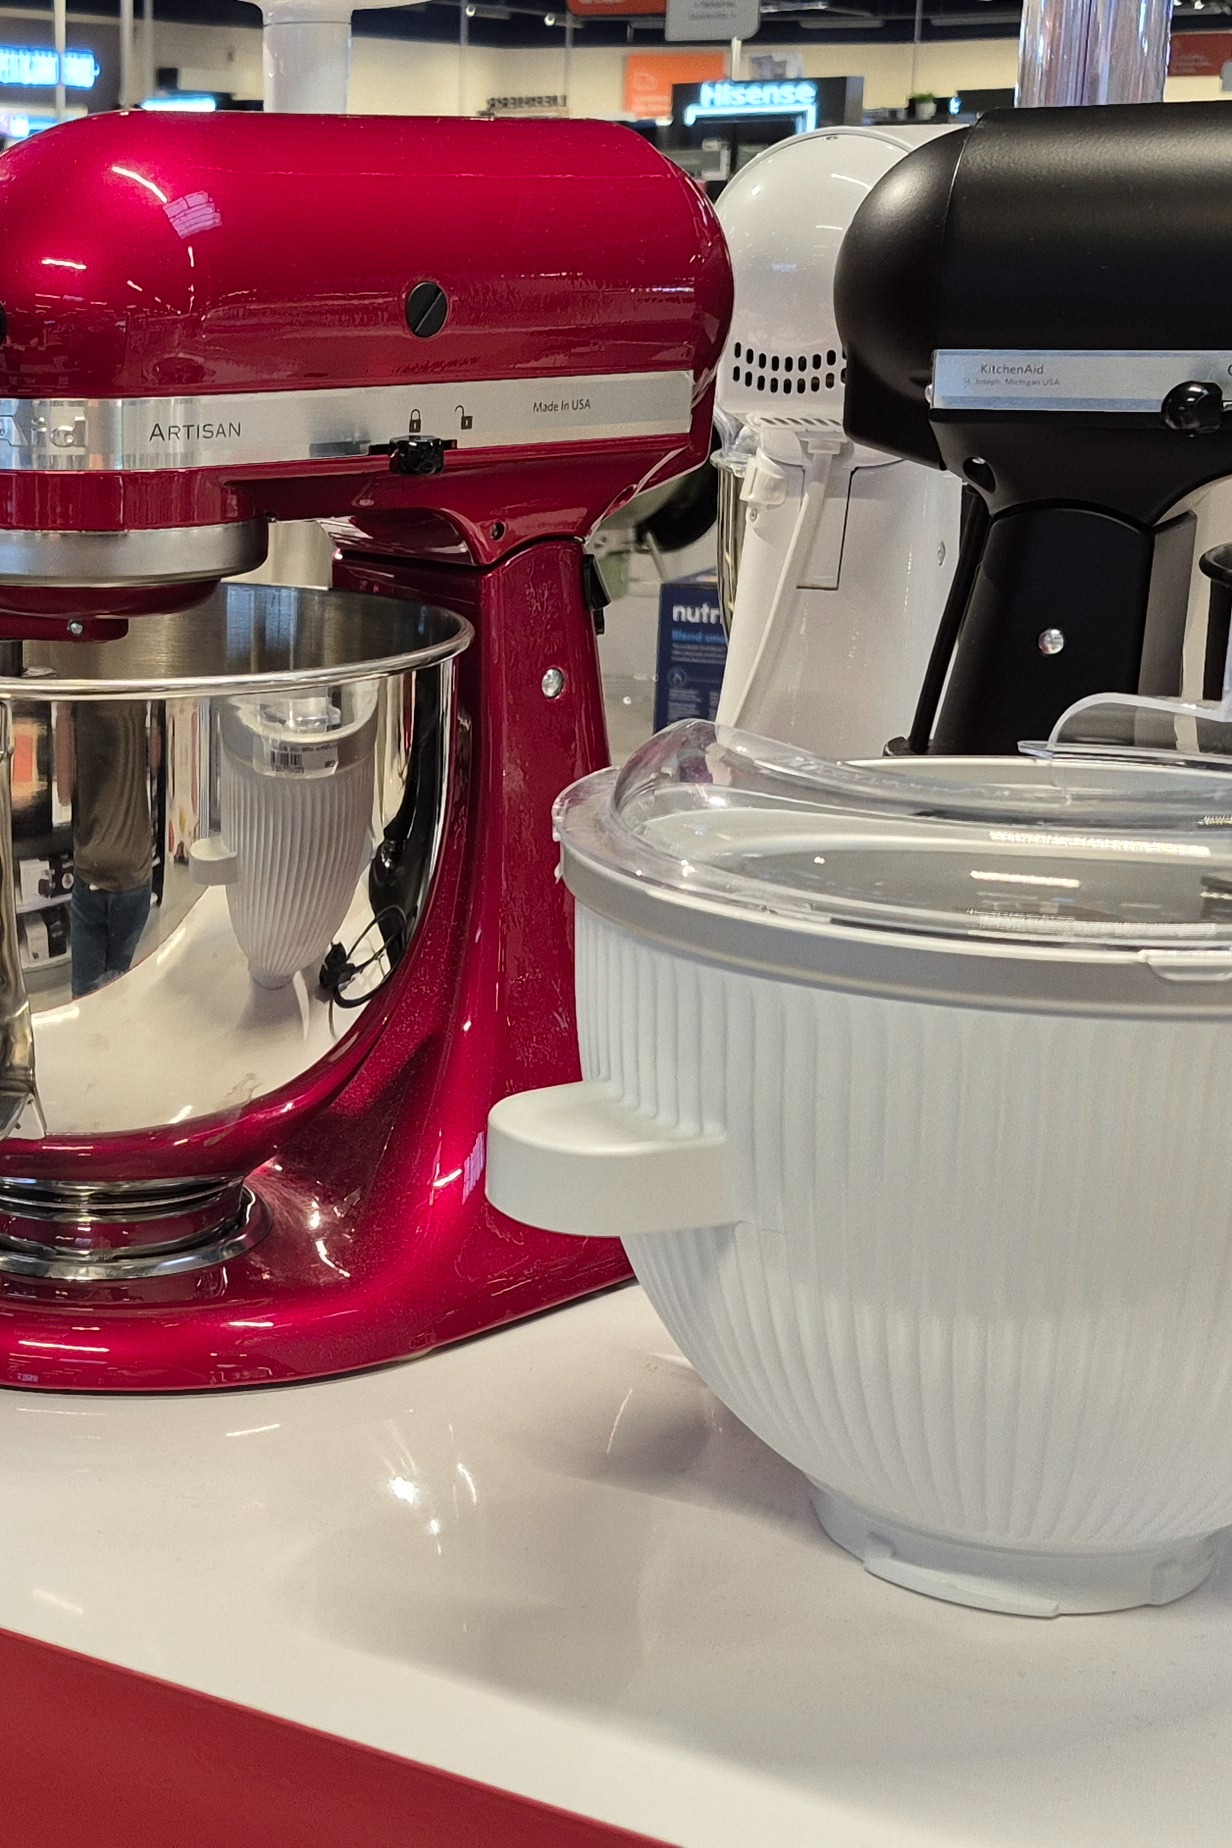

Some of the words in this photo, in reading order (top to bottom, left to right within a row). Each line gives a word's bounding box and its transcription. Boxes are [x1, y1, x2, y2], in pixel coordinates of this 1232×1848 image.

[701, 80, 816, 106] Hisense
[980, 364, 1044, 375] KitchenAid
[1042, 378, 1060, 386] USA
[533, 401, 559, 412] Made
[561, 400, 569, 411] In
[571, 399, 591, 410] USA
